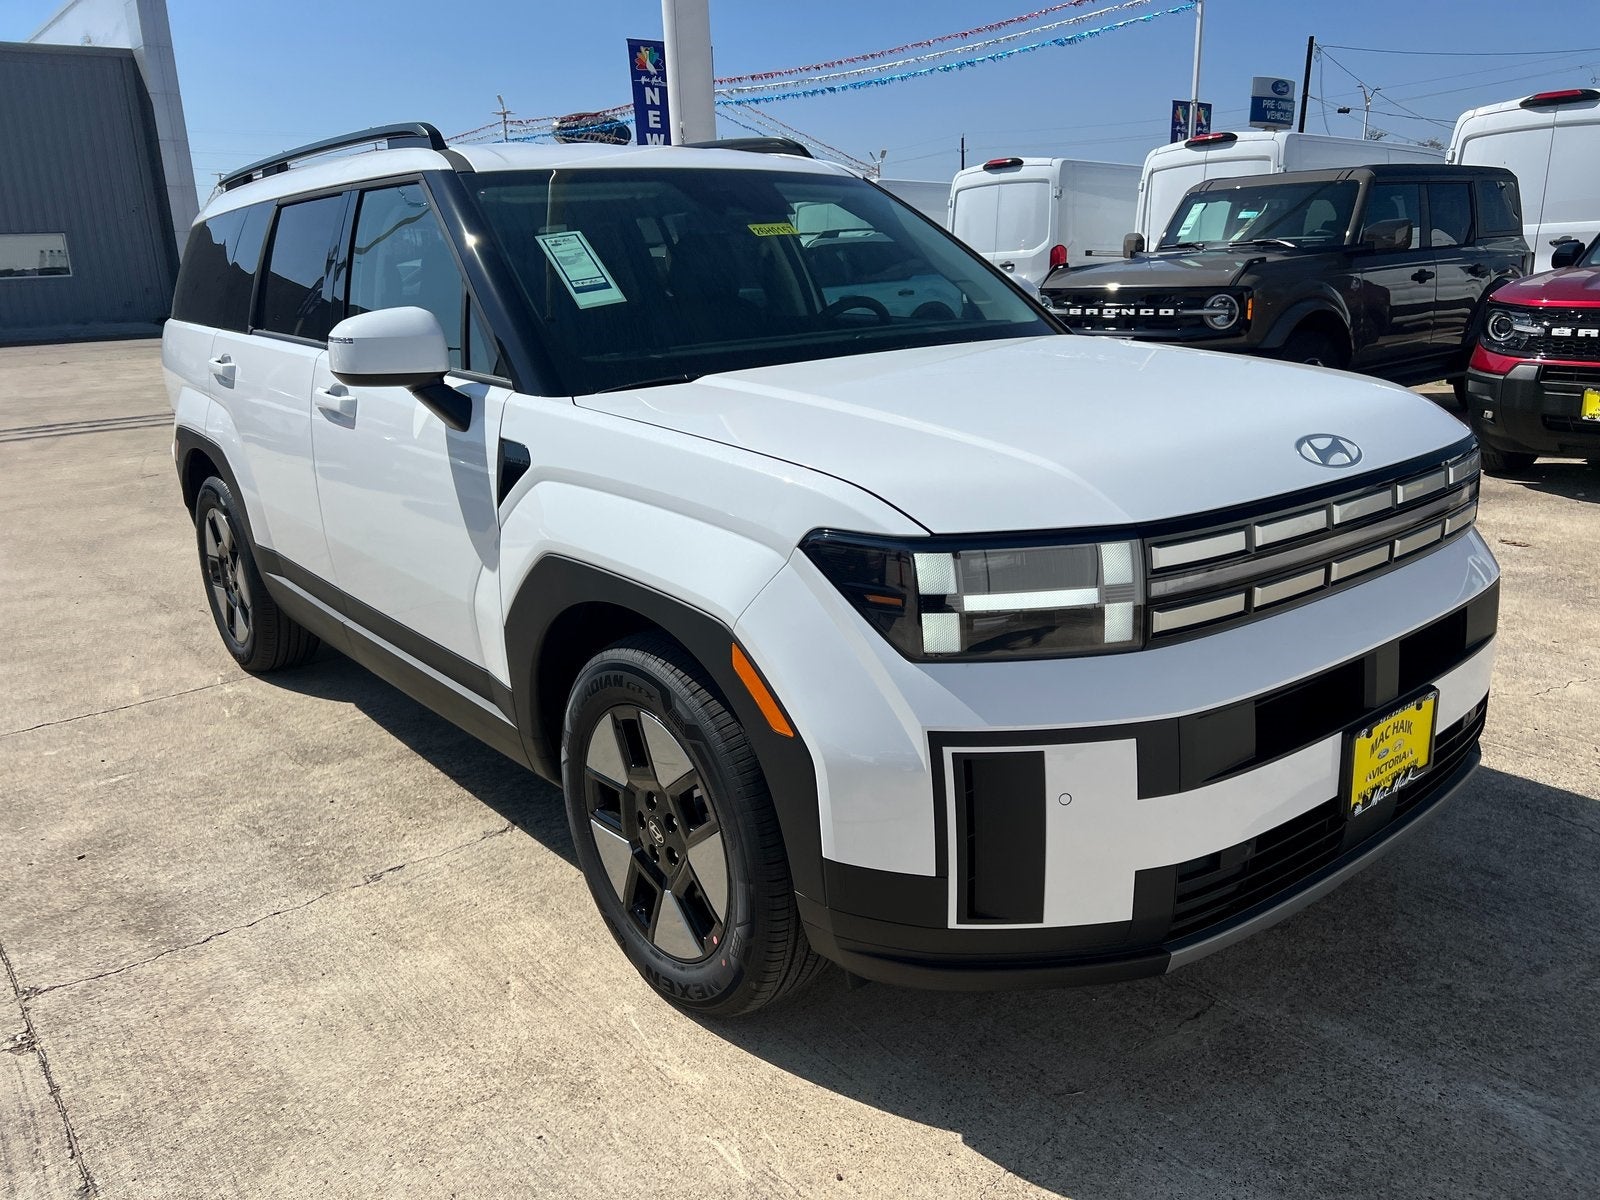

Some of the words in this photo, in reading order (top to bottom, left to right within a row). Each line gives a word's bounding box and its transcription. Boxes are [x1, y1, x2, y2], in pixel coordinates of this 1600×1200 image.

[645, 87, 665, 145] NEW
[1069, 308, 1175, 316] BRONCO
[1370, 725, 1391, 758] MAC
[1391, 719, 1413, 736] HAIK
[1371, 751, 1408, 779] VICTORIA
[644, 964, 722, 1000] NEXEN
